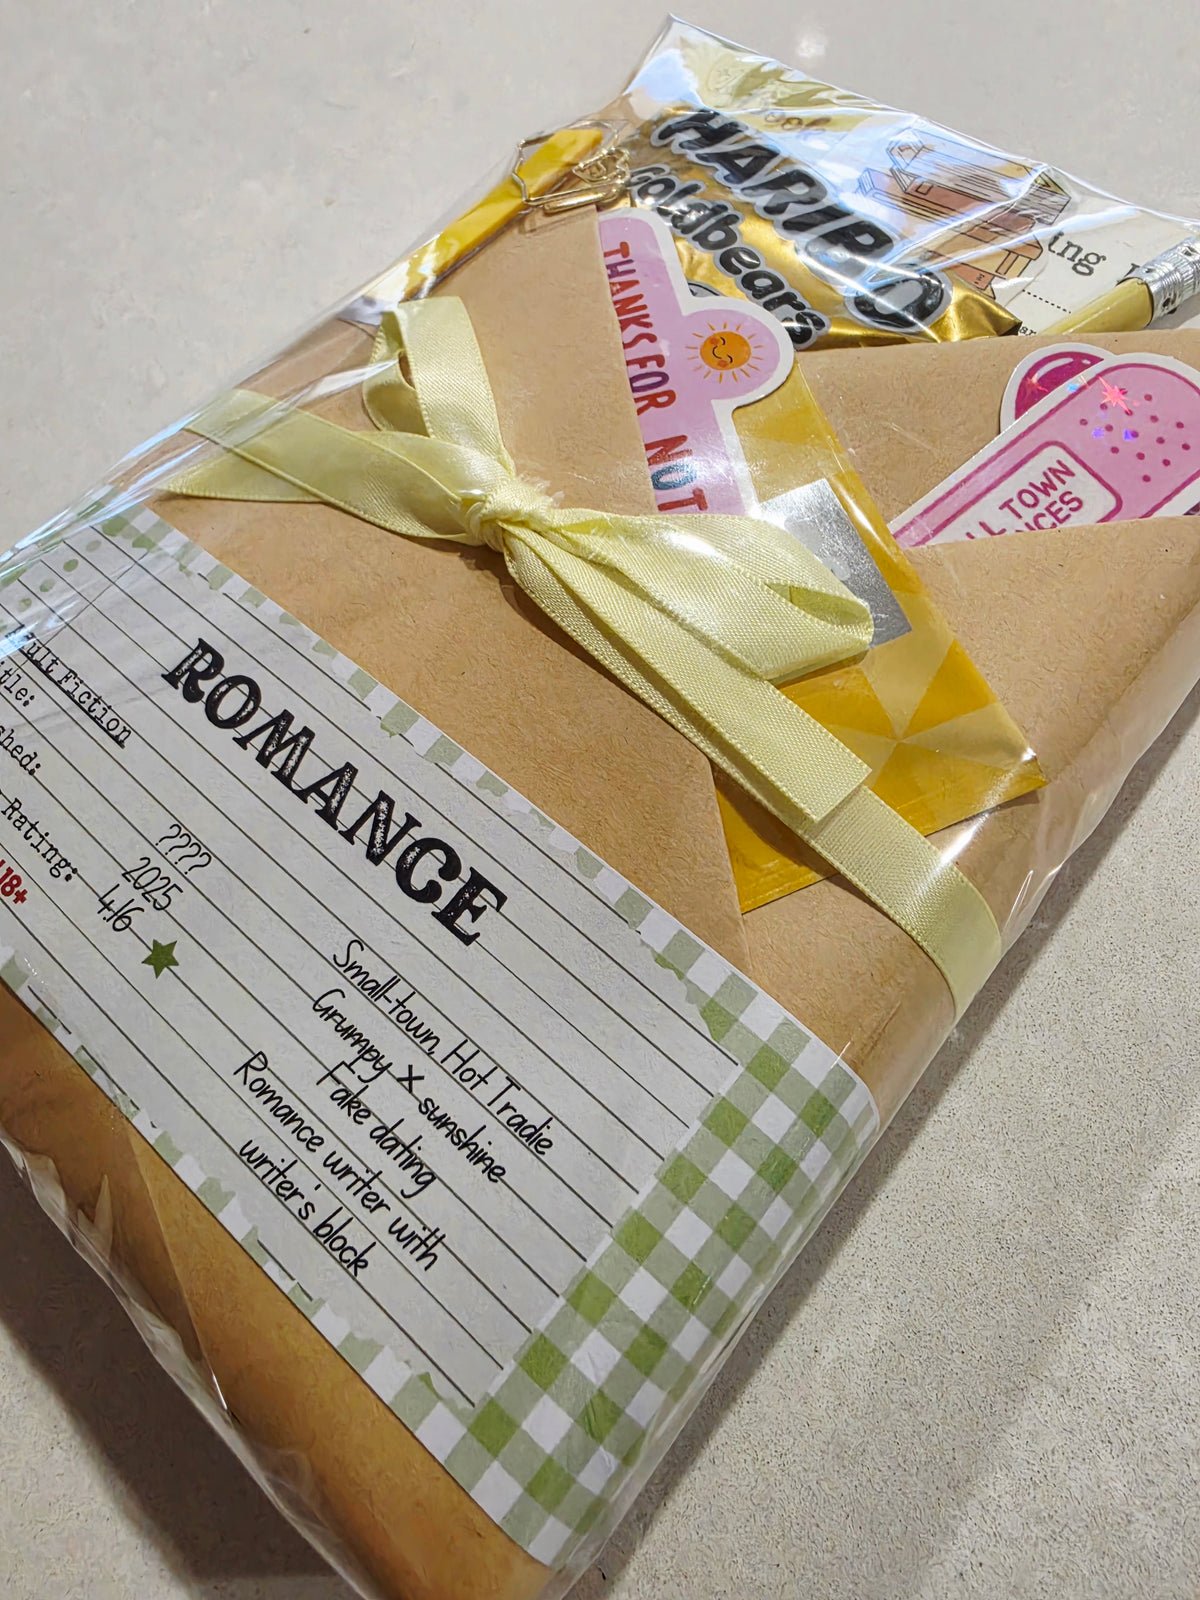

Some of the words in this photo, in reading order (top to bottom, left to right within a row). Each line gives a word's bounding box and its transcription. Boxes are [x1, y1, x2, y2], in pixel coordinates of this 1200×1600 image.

[654, 107, 948, 331] HARIBO
[1048, 231, 1107, 276] ing
[603, 241, 658, 350] THANKS
[626, 354, 677, 416] FOR
[645, 434, 708, 511] NOT
[998, 459, 1076, 520] TOWN
[0, 661, 35, 707] tle:
[57, 667, 132, 747] Fiction
[161, 638, 508, 947] ROMANCE
[1, 797, 78, 882] Rating:
[155, 823, 212, 875] ????
[0, 859, 28, 904] 18+
[122, 857, 184, 911] 2025
[312, 988, 393, 1084] Grumpy
[418, 1097, 506, 1183] sunshine
[440, 1039, 498, 1090] Hot
[487, 1076, 554, 1156] Tradie
[233, 1051, 325, 1153] Romance
[322, 1151, 391, 1214] writer
[389, 1216, 446, 1272] with
[316, 1060, 372, 1125] Fake
[369, 1118, 436, 1199] dating
[239, 1140, 322, 1221] writer's
[313, 1206, 377, 1276] block
